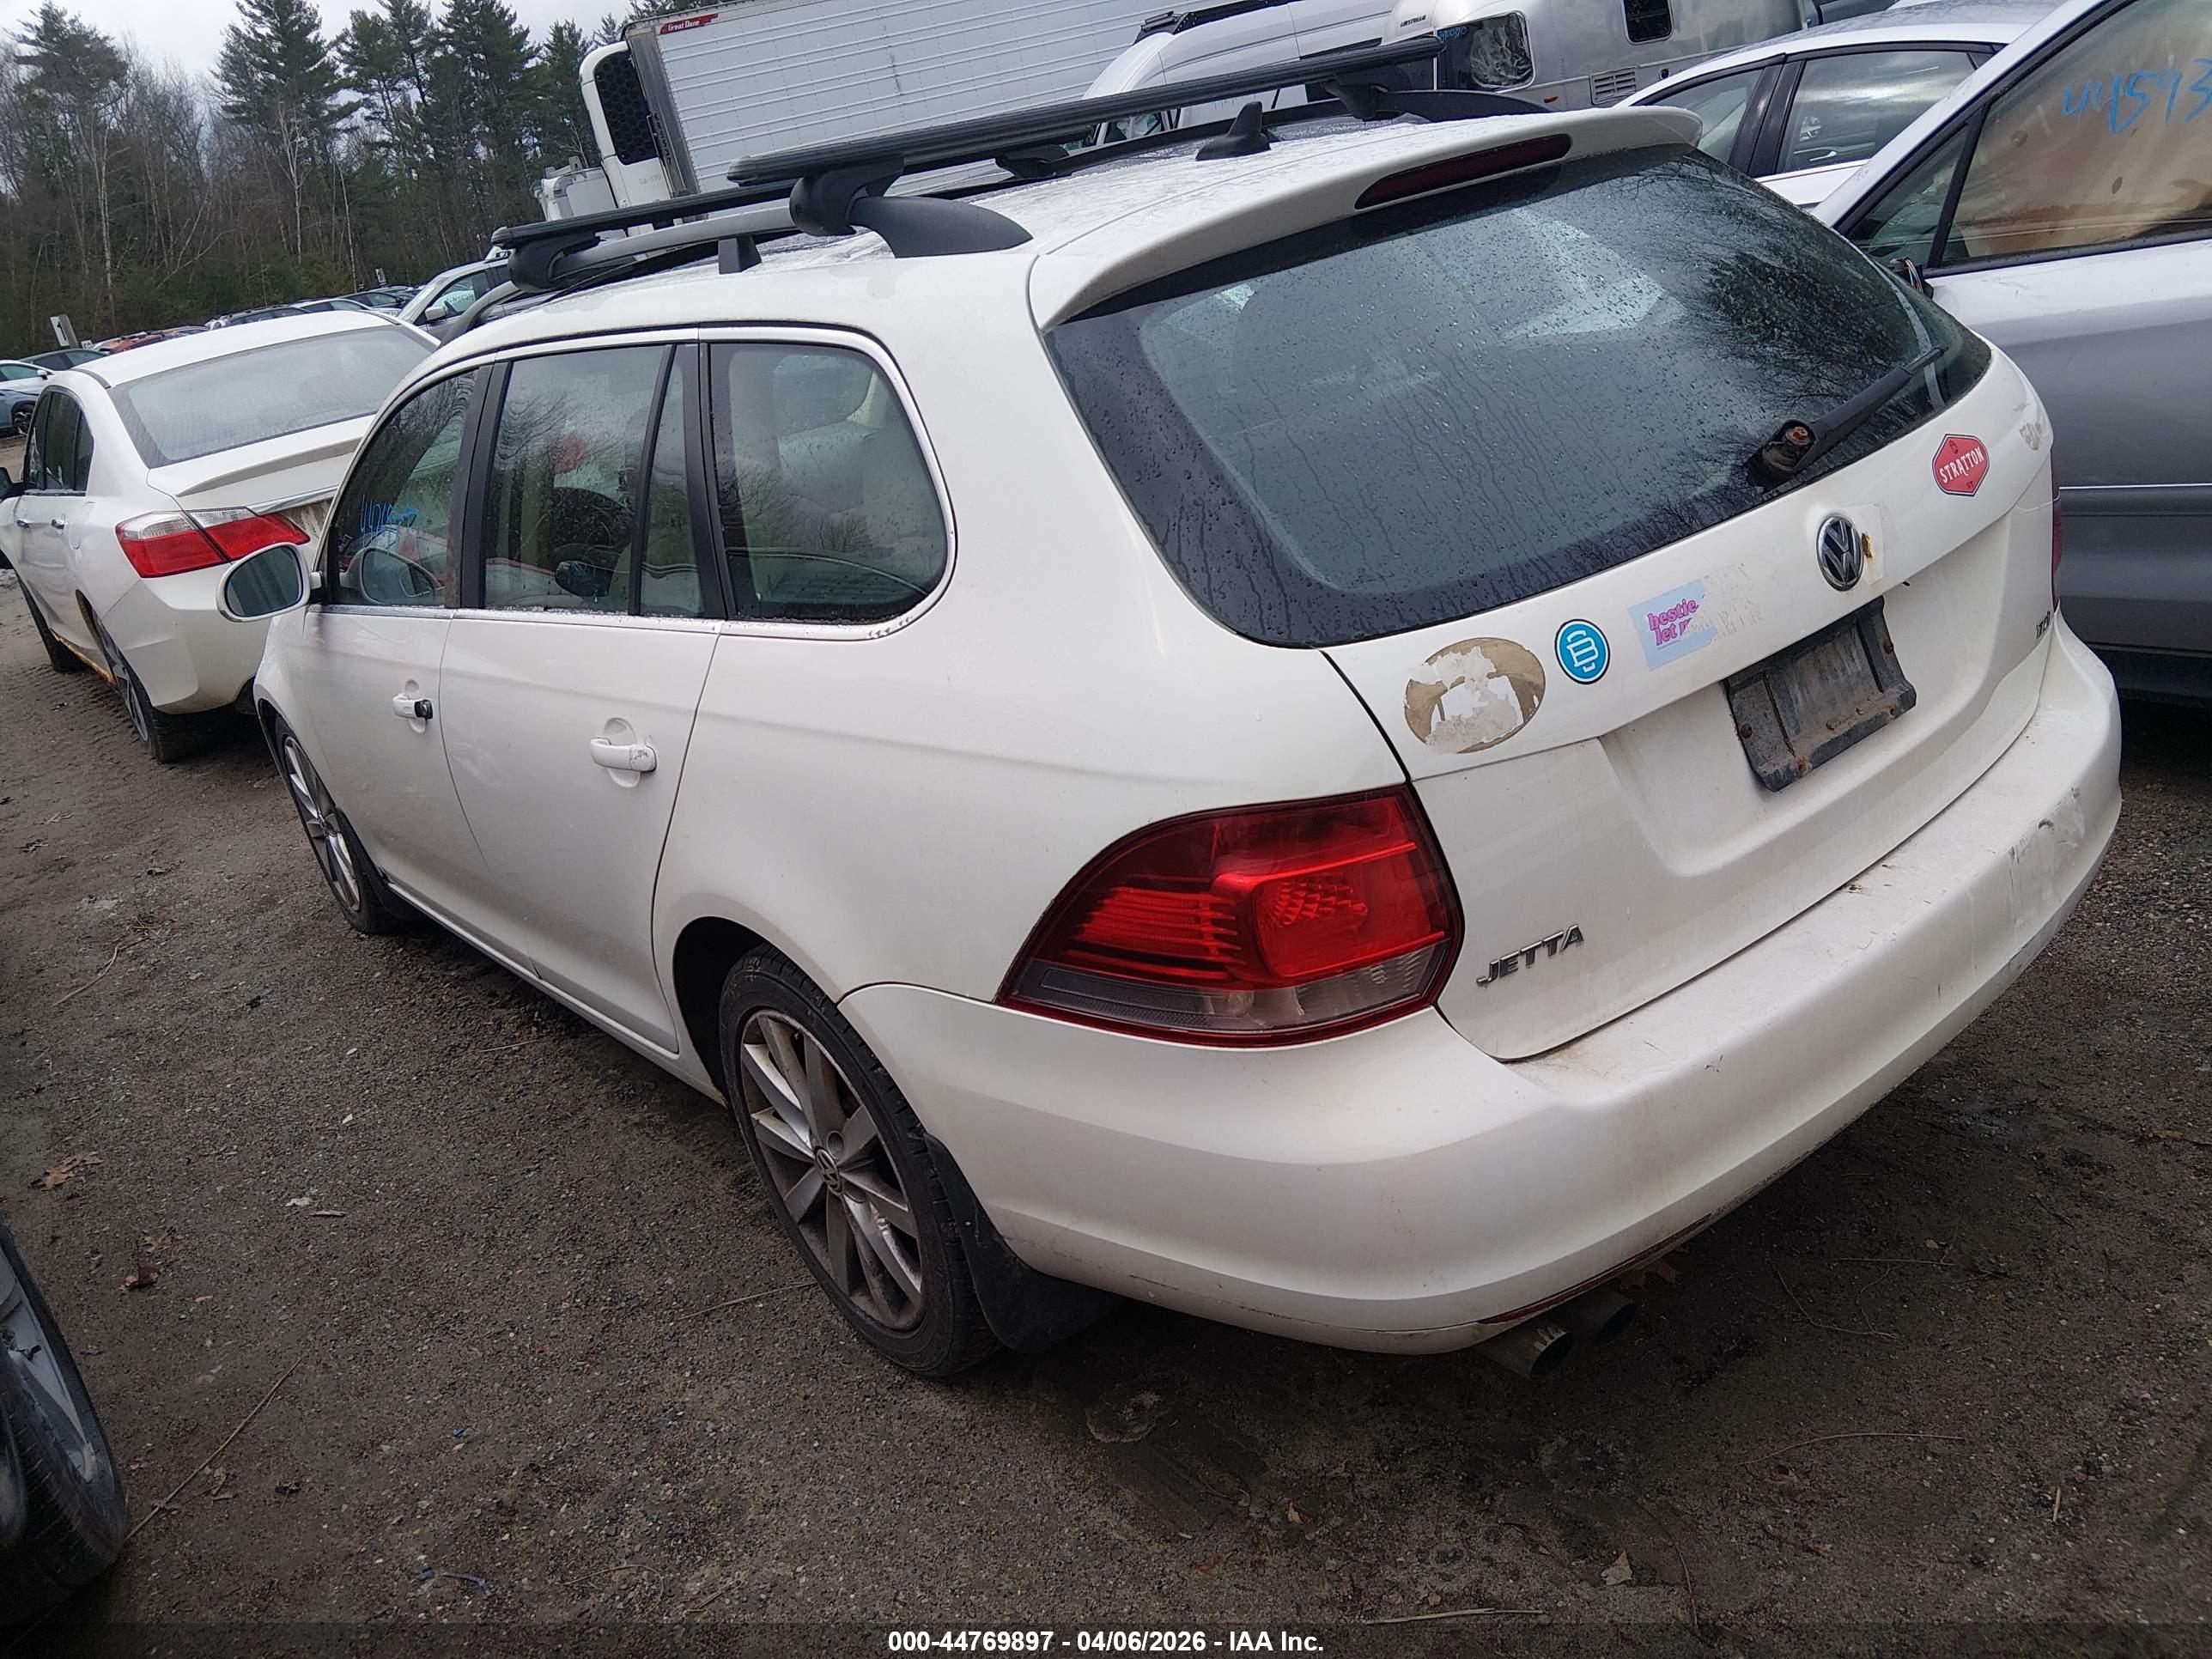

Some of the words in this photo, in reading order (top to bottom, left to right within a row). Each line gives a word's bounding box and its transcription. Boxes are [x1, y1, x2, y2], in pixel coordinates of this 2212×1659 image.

[668, 22, 684, 32] Great
[684, 20, 701, 28] Dane
[1939, 447, 1984, 483] STRATTON
[1647, 599, 1699, 631] bestie
[1653, 620, 1678, 646] let
[1476, 924, 1584, 985] JETTA
